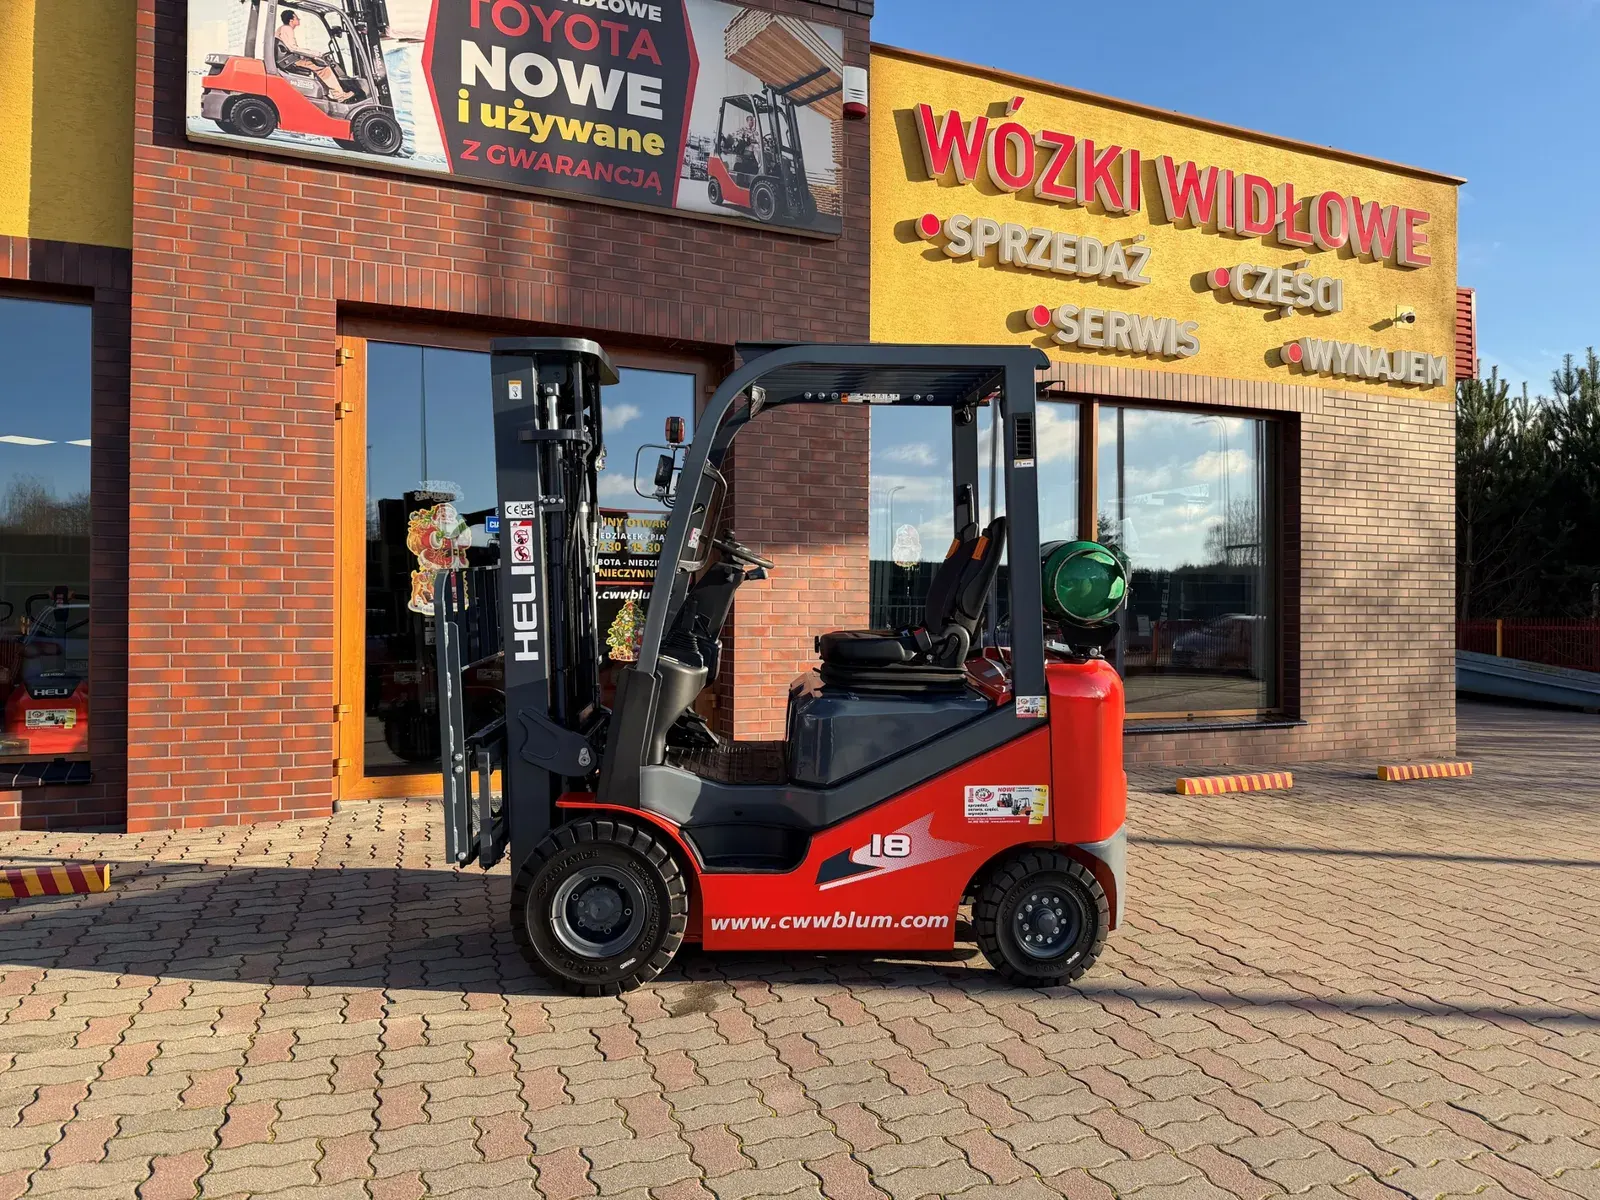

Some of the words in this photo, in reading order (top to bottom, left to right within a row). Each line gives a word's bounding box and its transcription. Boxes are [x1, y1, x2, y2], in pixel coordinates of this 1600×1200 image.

[467, 0, 662, 65] TOYOTA
[562, 0, 662, 22] ŁOWE
[460, 39, 664, 120] NOWE
[458, 88, 469, 123] i
[480, 99, 665, 156] używane
[460, 139, 480, 161] Z
[485, 143, 663, 196] GWARANCJĄ
[914, 96, 1141, 215] WÓZKI
[1155, 155, 1432, 269] WIDŁOWE
[1229, 260, 1343, 318] CZĘŚCI
[1051, 304, 1200, 358] SERWIS
[1300, 337, 1447, 386] WYNAJEM
[628, 559, 659, 567] NIEDZI
[650, 533, 666, 543] PIĄ
[511, 565, 539, 662] HELI
[595, 589, 650, 600] .cwwblu
[34, 688, 68, 696] HELI
[870, 834, 911, 858] 18
[710, 911, 949, 931] www.cwwblum.com
